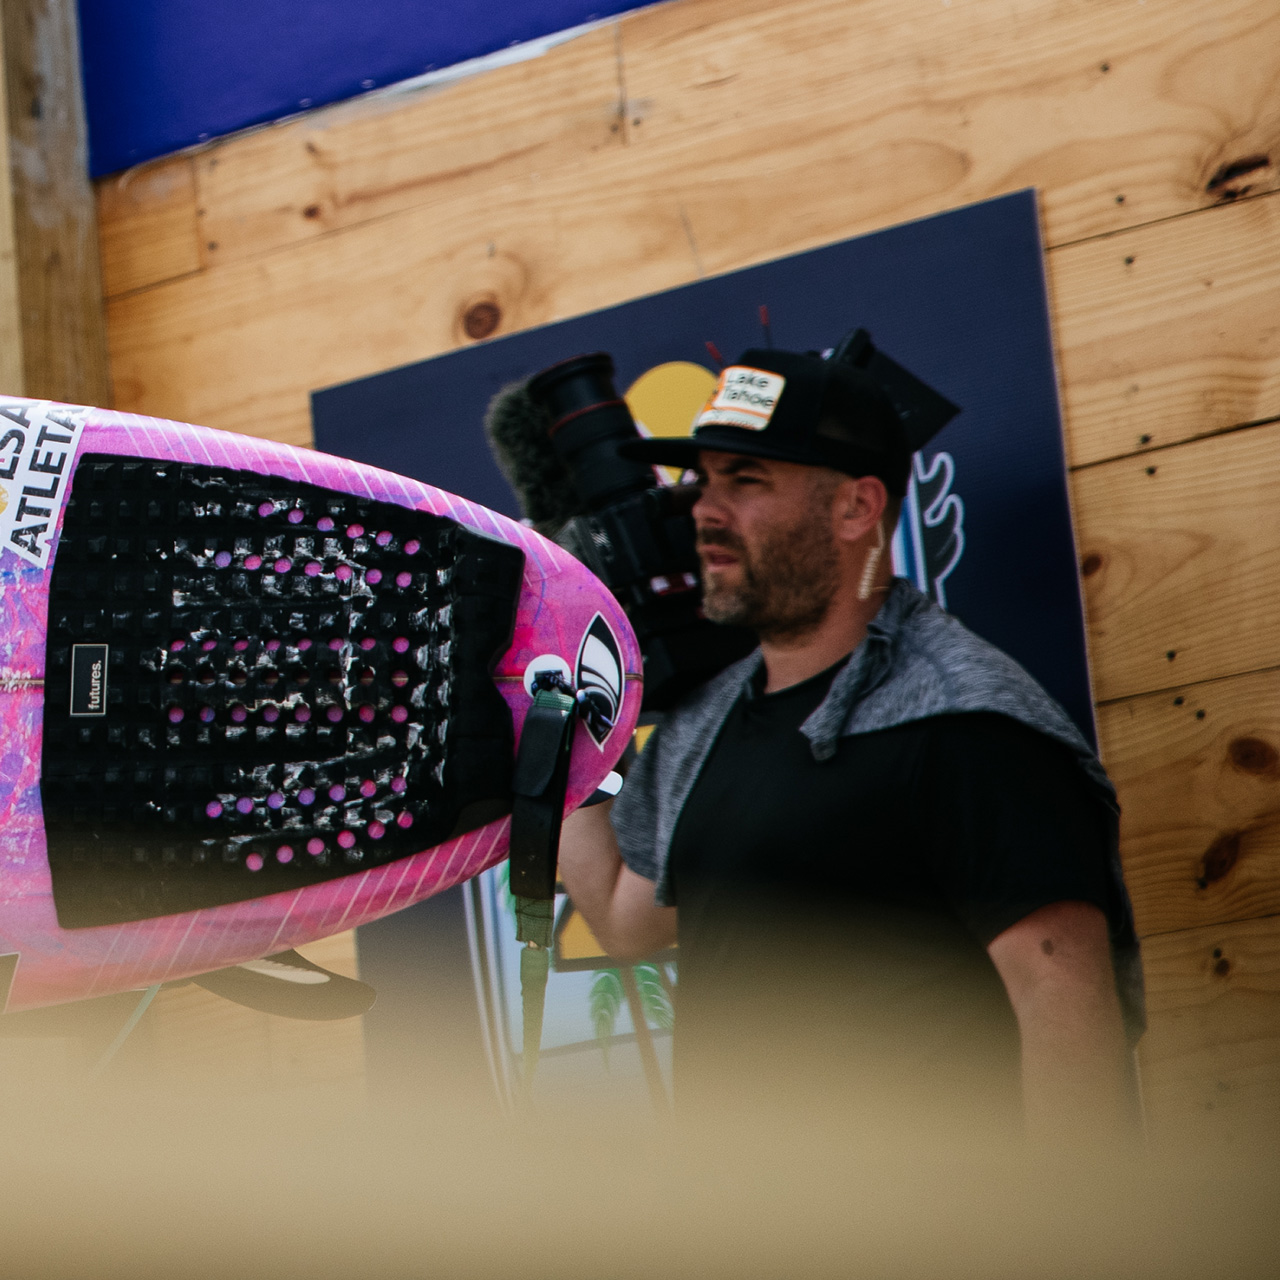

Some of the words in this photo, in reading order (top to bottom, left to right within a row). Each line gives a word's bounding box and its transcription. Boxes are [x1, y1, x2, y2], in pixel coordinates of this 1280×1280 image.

[723, 384, 775, 408] Tahoe
[727, 370, 769, 388] Lake
[10, 407, 86, 559] ATLETA
[87, 659, 103, 711] futures.
